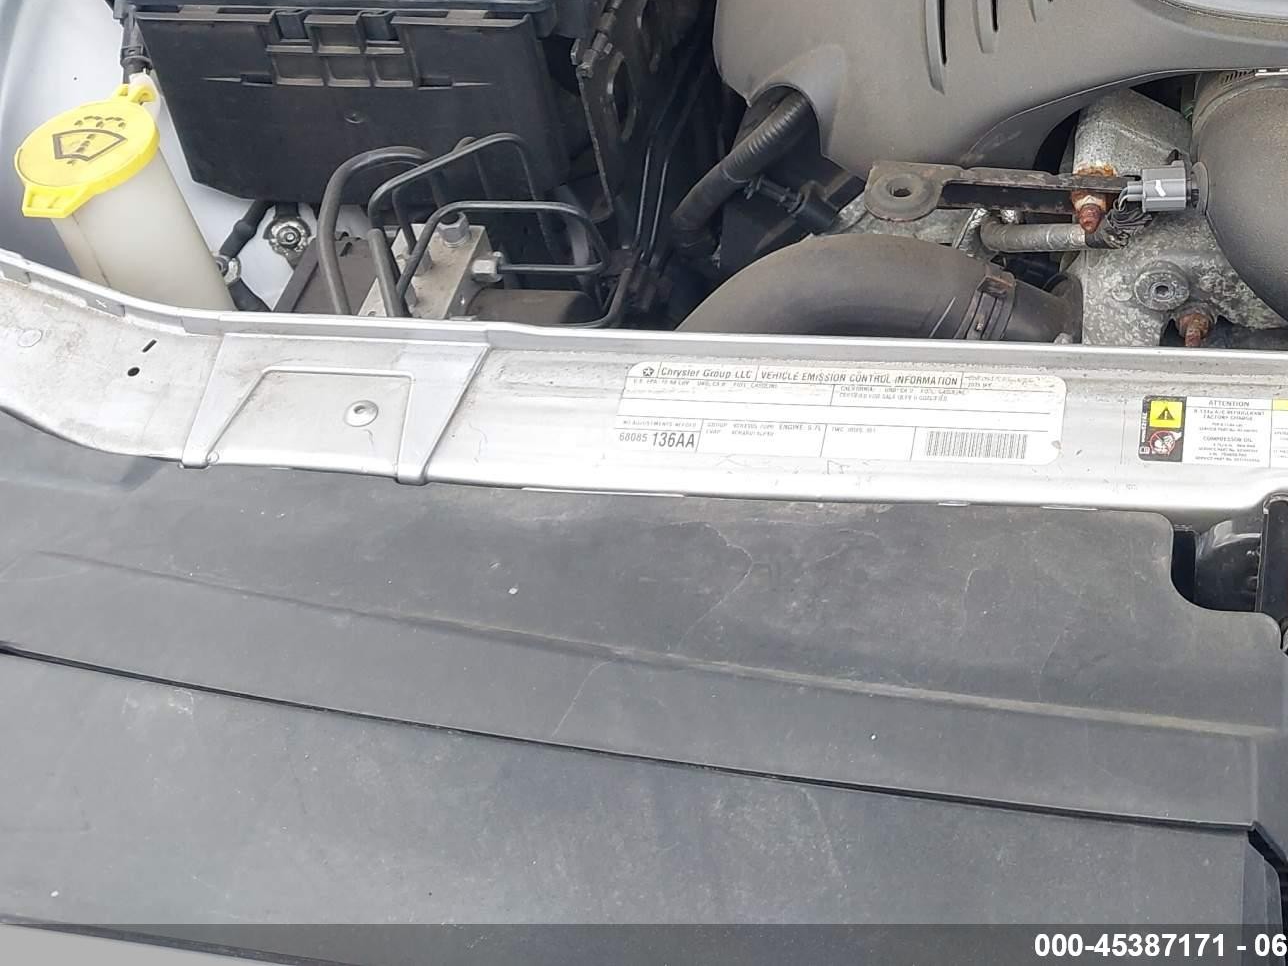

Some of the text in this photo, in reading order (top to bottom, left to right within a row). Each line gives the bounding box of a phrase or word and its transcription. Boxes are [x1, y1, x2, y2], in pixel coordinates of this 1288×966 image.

[661, 367, 752, 380] Chrysler Group LLC
[761, 371, 798, 381] VEHICLE
[802, 372, 846, 383] EMISSION
[850, 373, 890, 384] CONTROL
[894, 375, 957, 386] INFORMATION
[619, 432, 648, 442] 68085
[652, 433, 695, 448] 136AA
